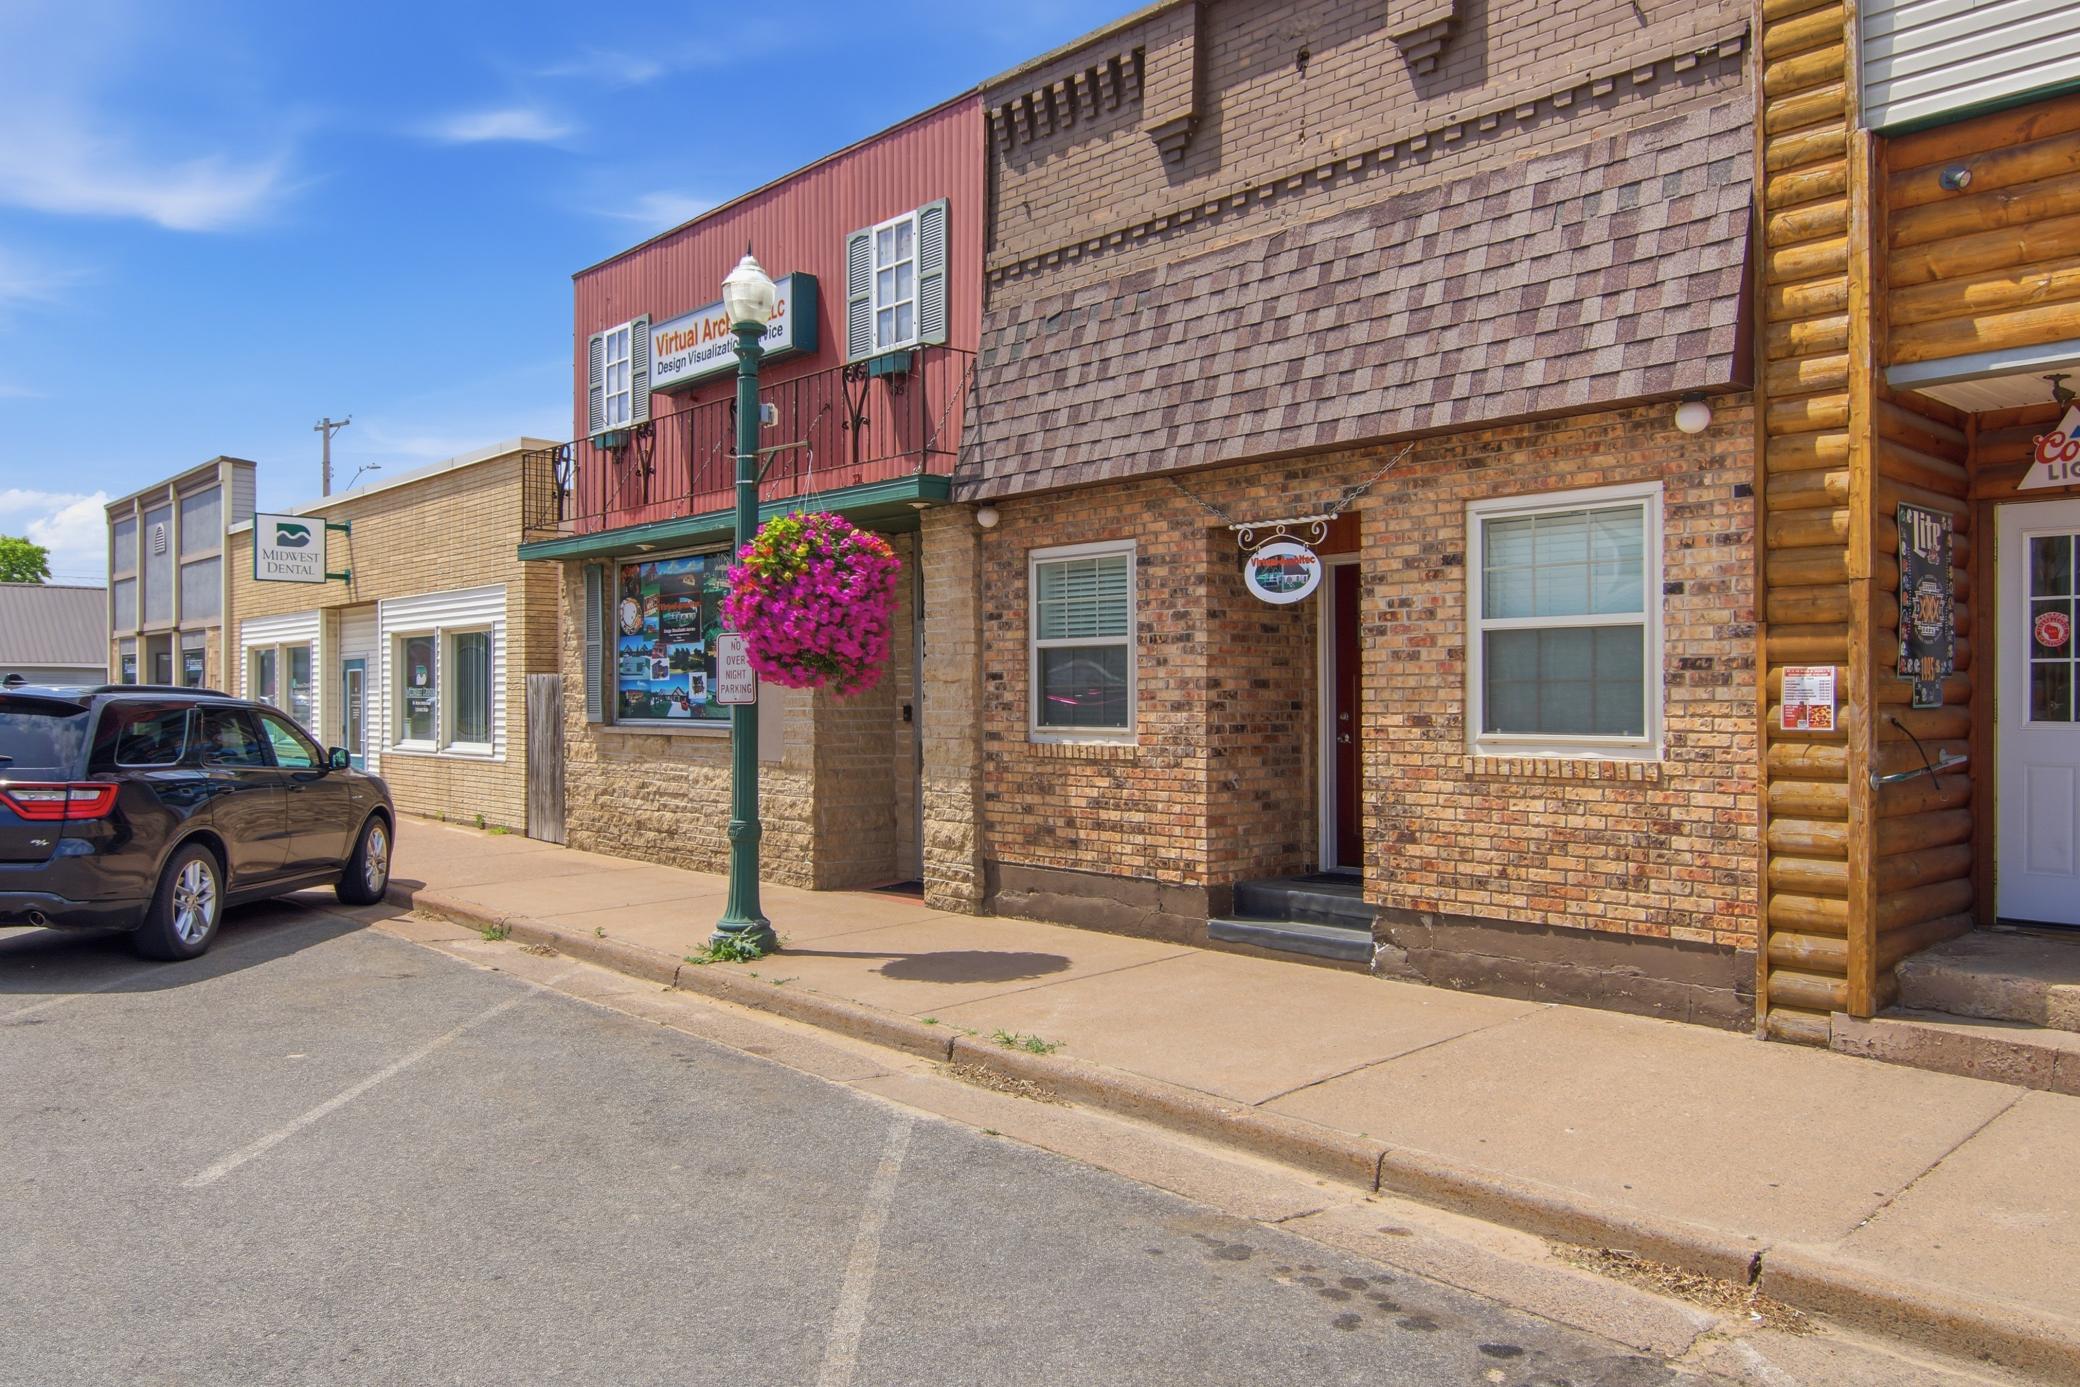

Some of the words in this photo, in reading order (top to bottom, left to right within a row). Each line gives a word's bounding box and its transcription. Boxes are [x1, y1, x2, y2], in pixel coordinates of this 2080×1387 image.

[656, 322, 698, 357] Virtual
[768, 299, 785, 321] LC
[657, 356, 687, 375] Design
[688, 337, 740, 366] Visualizatio
[1913, 510, 1941, 558] Lite
[263, 549, 320, 563] MIDWEST
[267, 562, 315, 576] DENTAL
[731, 641, 741, 651] NO
[726, 656, 746, 666] OVER
[726, 669, 747, 680] NIGHT
[721, 684, 752, 694] PARKING
